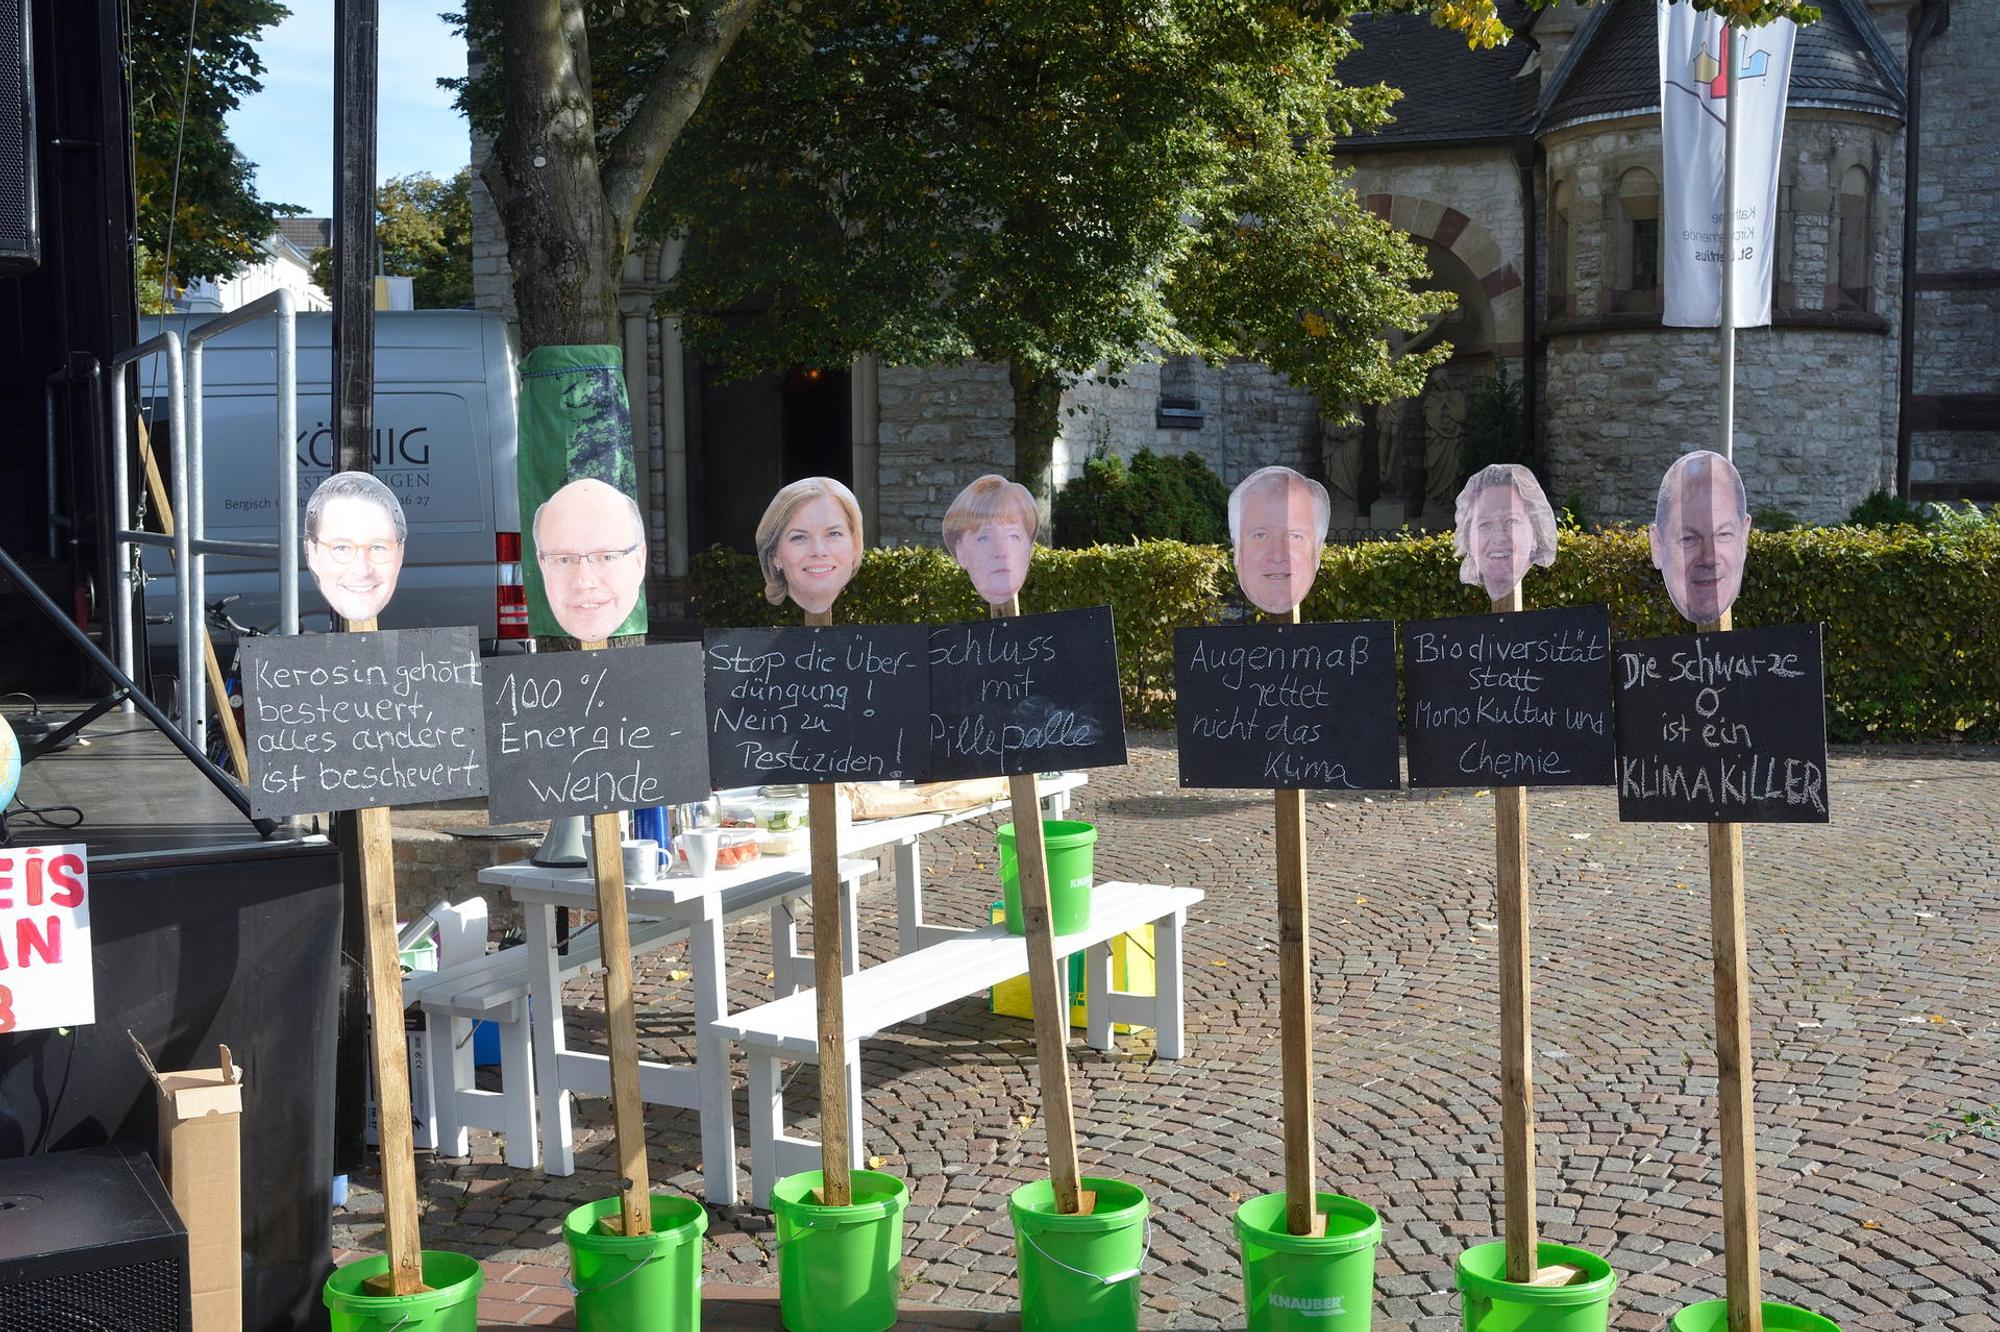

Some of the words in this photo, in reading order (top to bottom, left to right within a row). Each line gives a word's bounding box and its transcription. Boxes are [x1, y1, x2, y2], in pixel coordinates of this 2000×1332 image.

[225, 497, 271, 510] Bergisch
[417, 496, 430, 507] 27
[708, 644, 785, 684] Stop
[795, 641, 836, 672] die
[846, 634, 917, 676] Über-
[929, 627, 1056, 666] Schluss
[1190, 635, 1369, 690] Augenmaß
[1413, 629, 1606, 663] Biodiversität
[255, 658, 389, 692] Kerosin
[393, 651, 483, 697] gehört
[982, 666, 1035, 701] mit
[1618, 652, 1662, 690] Die
[257, 691, 433, 724] besteuert,
[496, 672, 562, 717] 100
[580, 668, 608, 717] %
[1250, 674, 1329, 709] rettet
[257, 728, 337, 753] alles
[352, 722, 468, 752] andere
[713, 707, 788, 733] Nein
[800, 714, 832, 732] zu
[1192, 706, 1258, 740] nicht
[1265, 715, 1321, 745] das
[1566, 708, 1605, 735] und
[1662, 712, 1691, 743] ist
[1702, 717, 1752, 748] ein
[929, 711, 1097, 774] Pillepalle
[1459, 738, 1571, 775] Chemie
[262, 763, 306, 793] ist
[319, 749, 480, 790] bescheuert
[1264, 752, 1361, 789] Klima
[1268, 1292, 1344, 1311] KNAUBER
